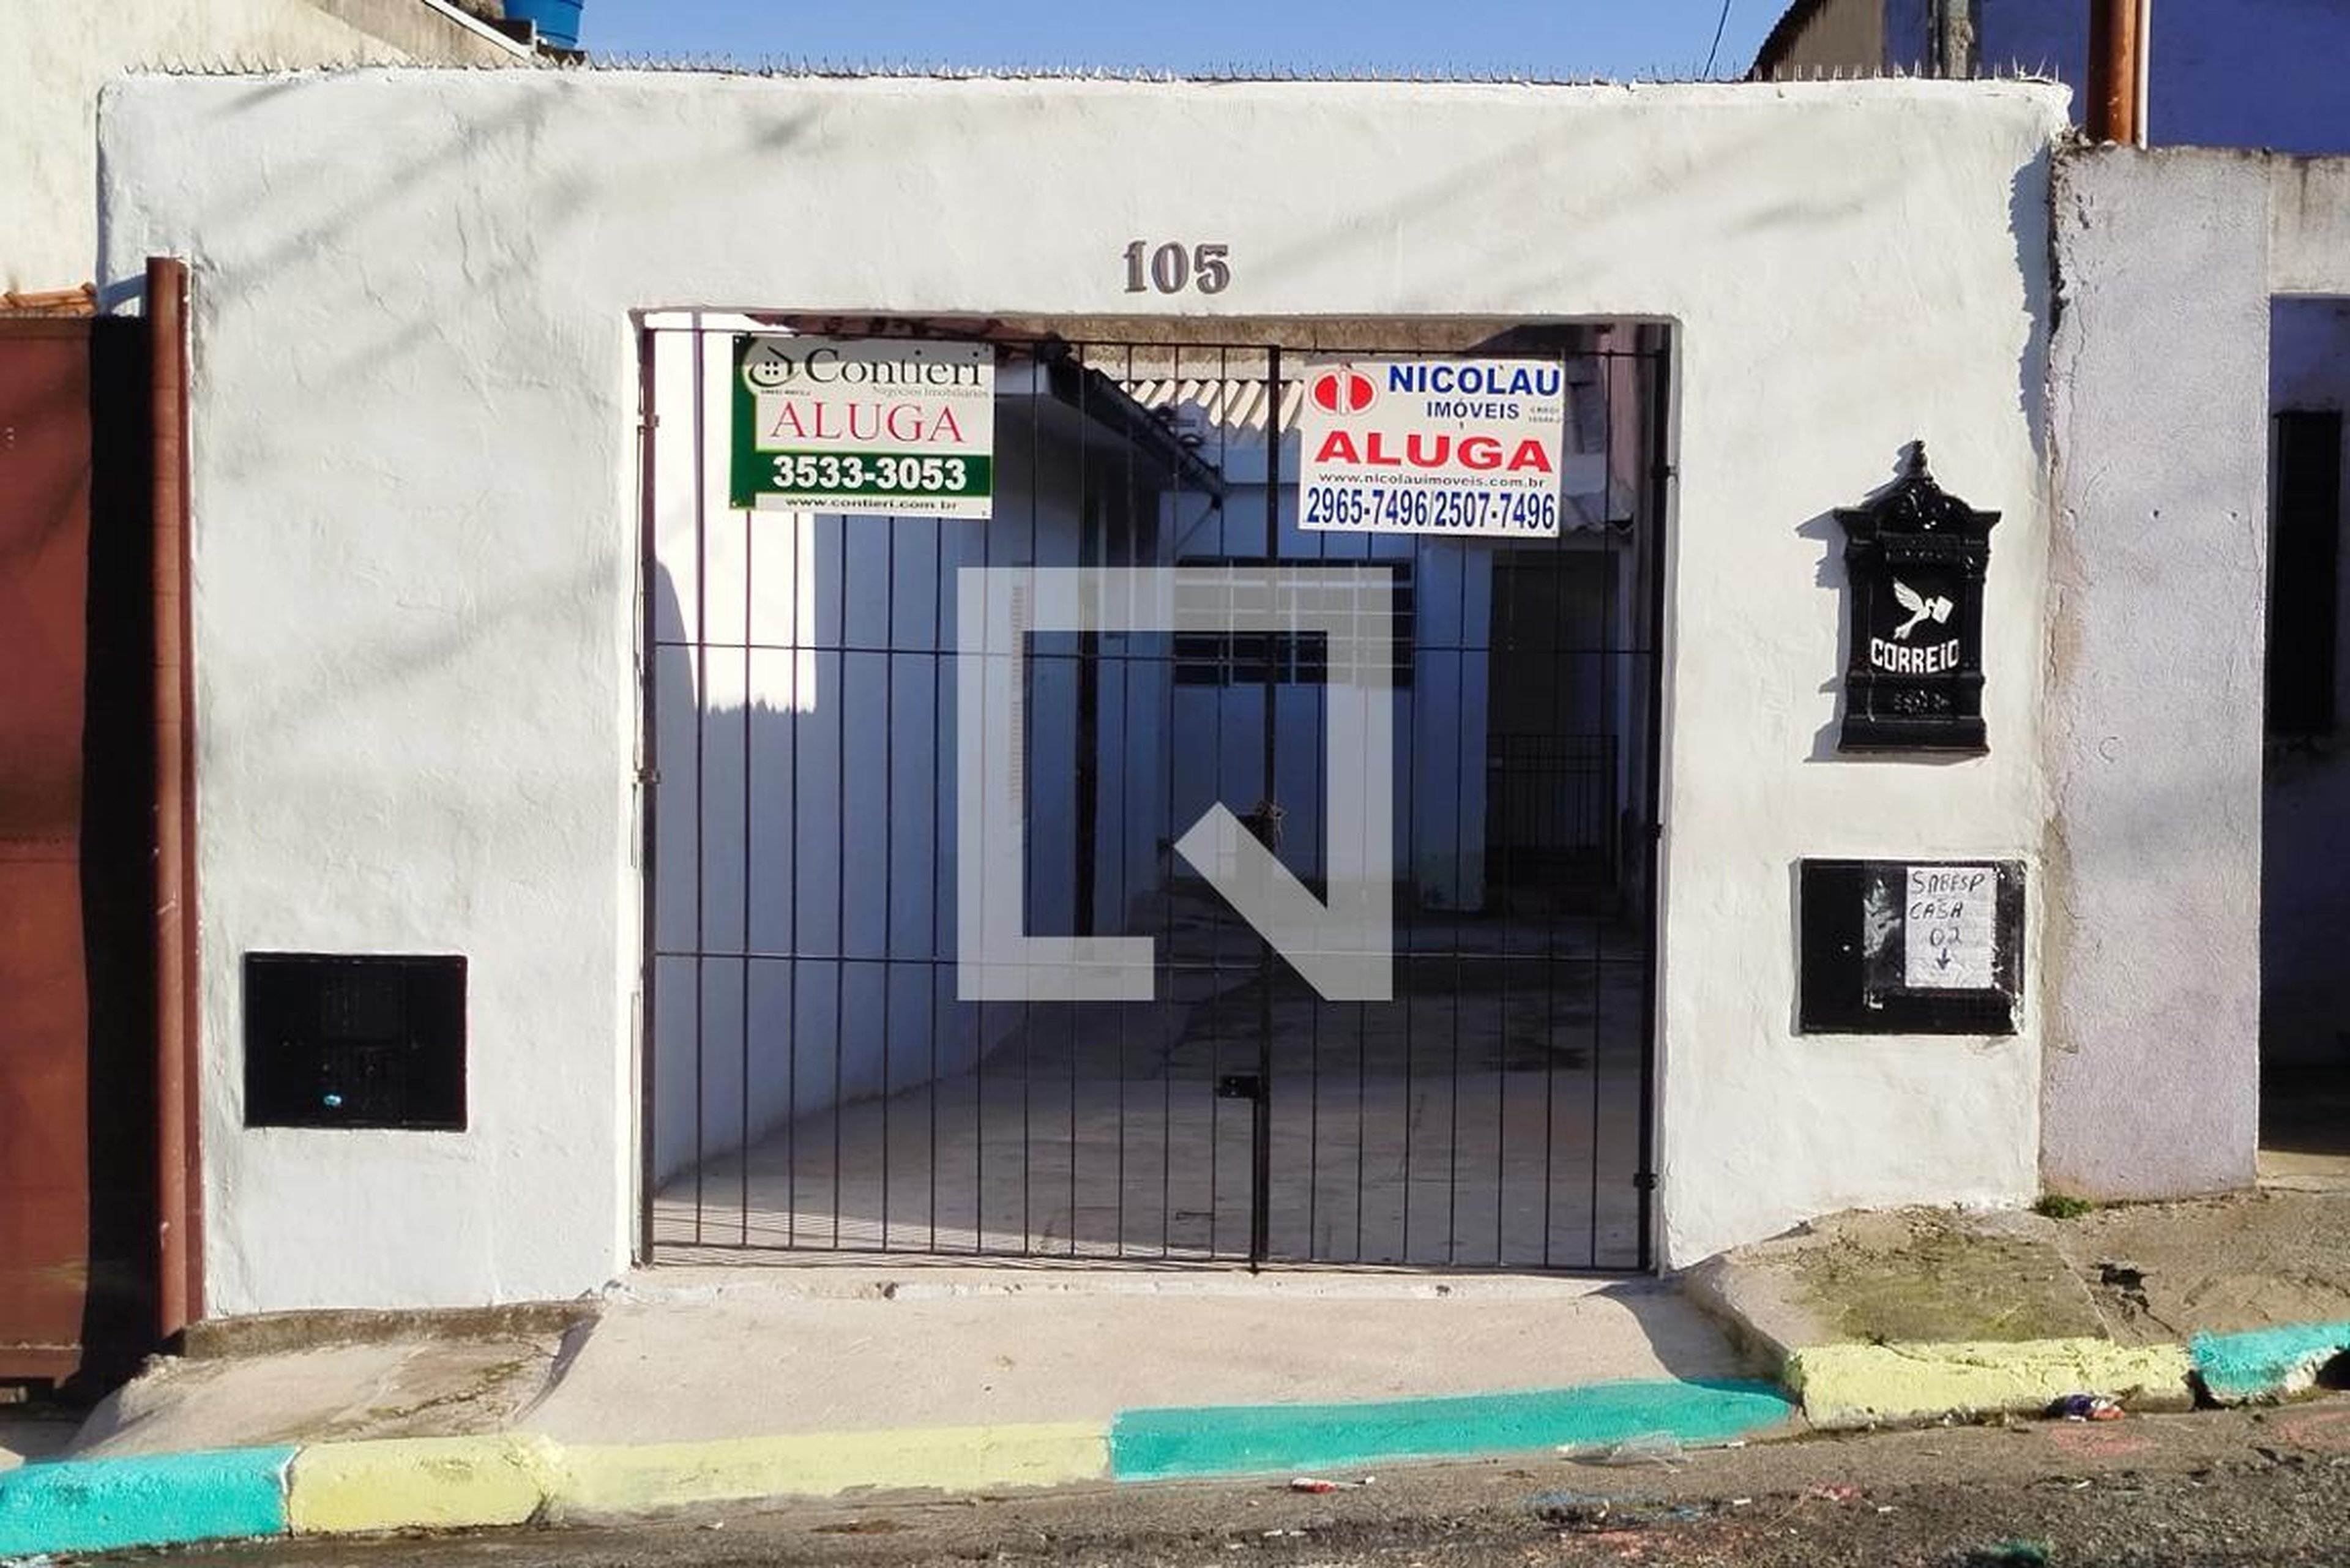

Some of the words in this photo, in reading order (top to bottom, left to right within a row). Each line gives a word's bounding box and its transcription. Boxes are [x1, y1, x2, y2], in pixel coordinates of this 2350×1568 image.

[1122, 241, 1231, 294] 105
[804, 347, 982, 387] Contieri
[1389, 365, 1560, 396] NICOLAU
[770, 401, 966, 443] ALUGA
[1427, 398, 1520, 419] IMÓVEIS
[1315, 430, 1553, 473] ALUGA
[772, 455, 966, 490] 3533-3053
[1319, 473, 1545, 488] www.nicolauimoveis.com.br
[786, 497, 957, 510] www.contieri.combr
[1909, 897, 1963, 919] CASA
[1930, 927, 1963, 946] 02
